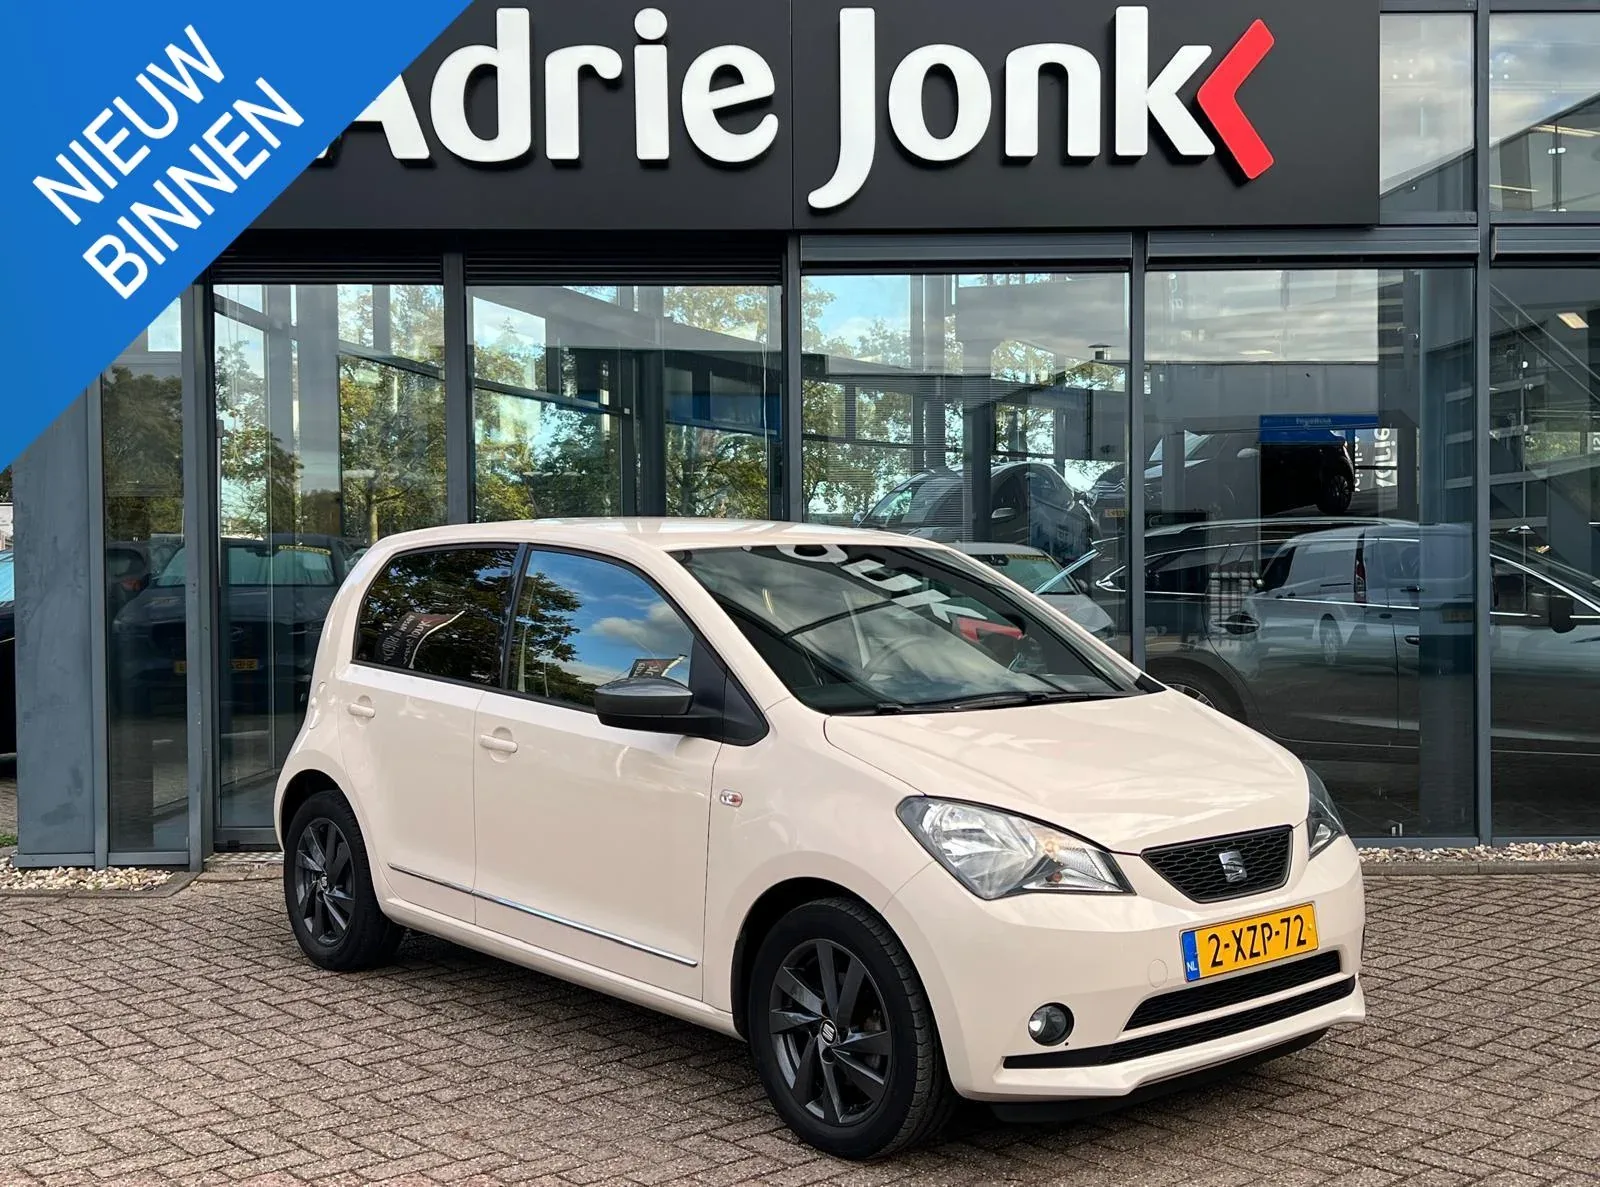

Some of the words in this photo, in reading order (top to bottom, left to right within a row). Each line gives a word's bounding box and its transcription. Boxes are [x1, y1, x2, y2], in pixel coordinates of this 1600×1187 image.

[808, 6, 1216, 208] Jonk
[1186, 960, 1198, 972] NL
[1207, 914, 1307, 968] 2-XZP-72
